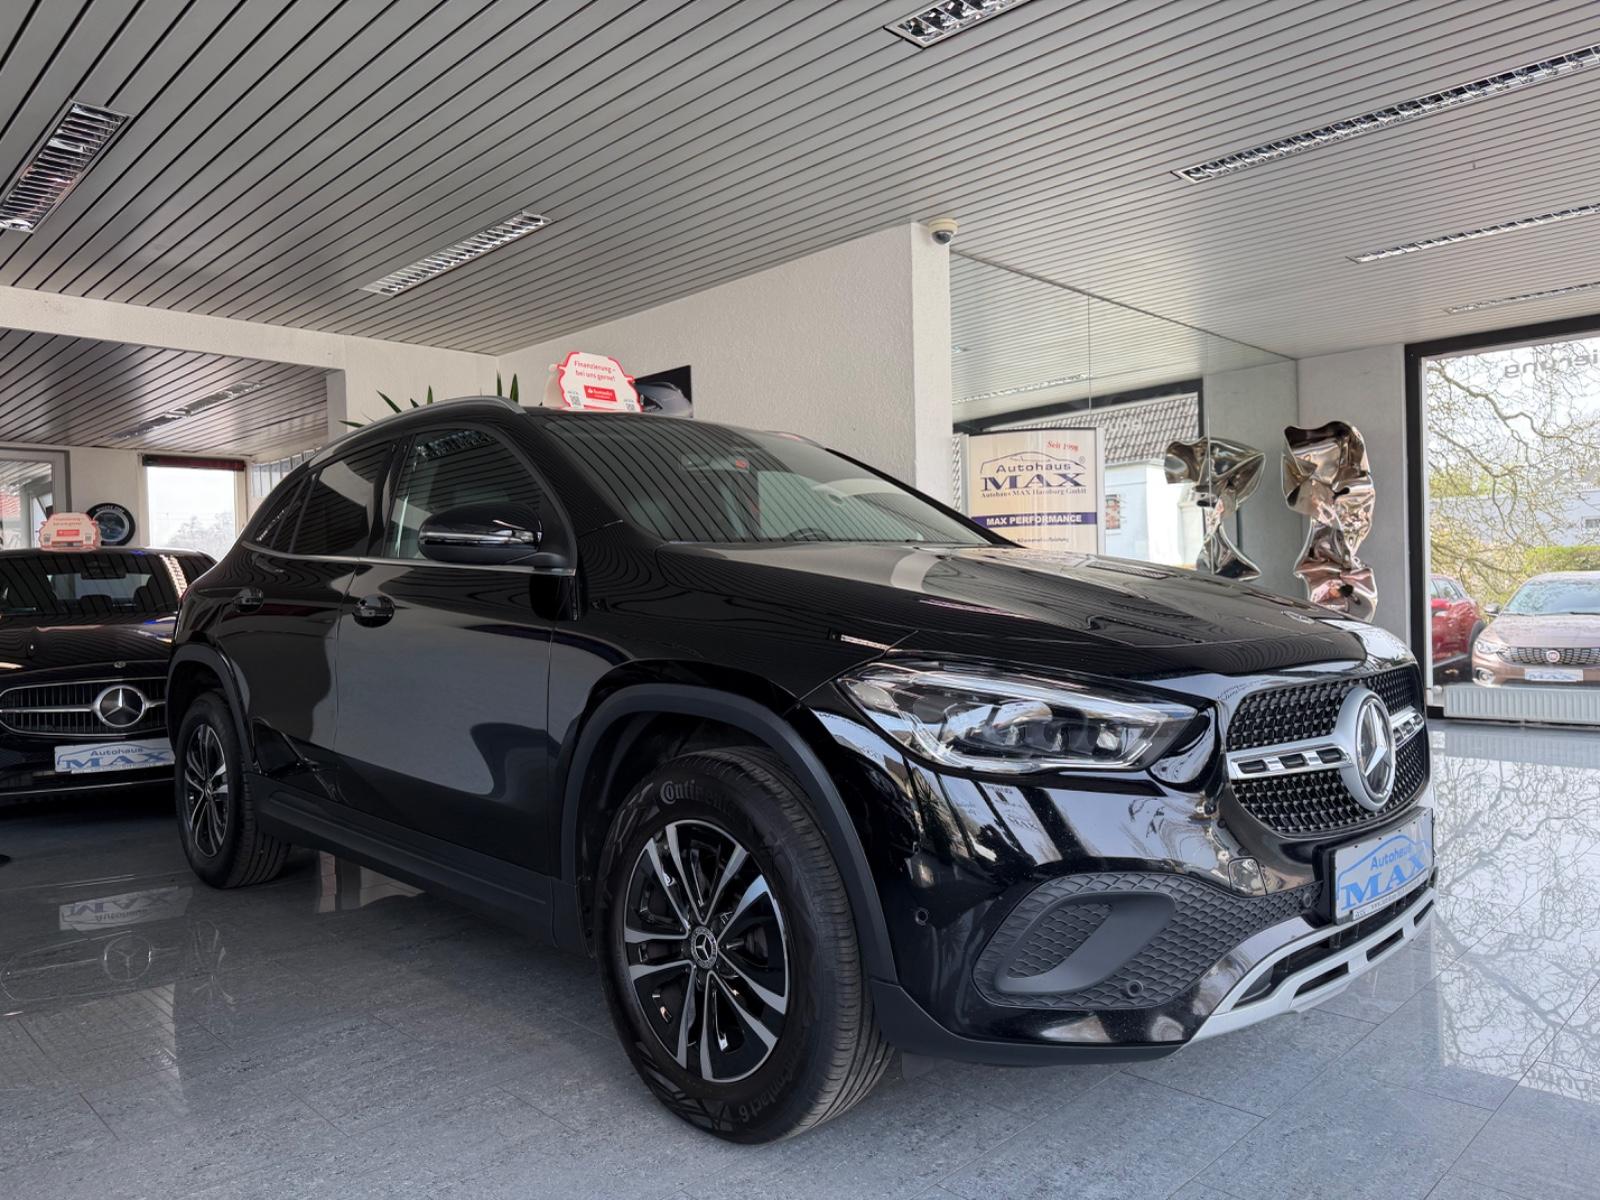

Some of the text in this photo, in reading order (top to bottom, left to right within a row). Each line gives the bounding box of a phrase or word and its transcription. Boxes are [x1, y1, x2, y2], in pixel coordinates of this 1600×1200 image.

[574, 360, 611, 373] Finanzierung
[995, 462, 1072, 473] Autohaus
[980, 472, 1088, 491] MAX
[986, 514, 1082, 526] MAX PERFORMANCE
[62, 750, 171, 769] MAX
[91, 748, 144, 756] Autohaus
[1370, 845, 1411, 871] Autohaus
[1341, 855, 1425, 912] MAX
